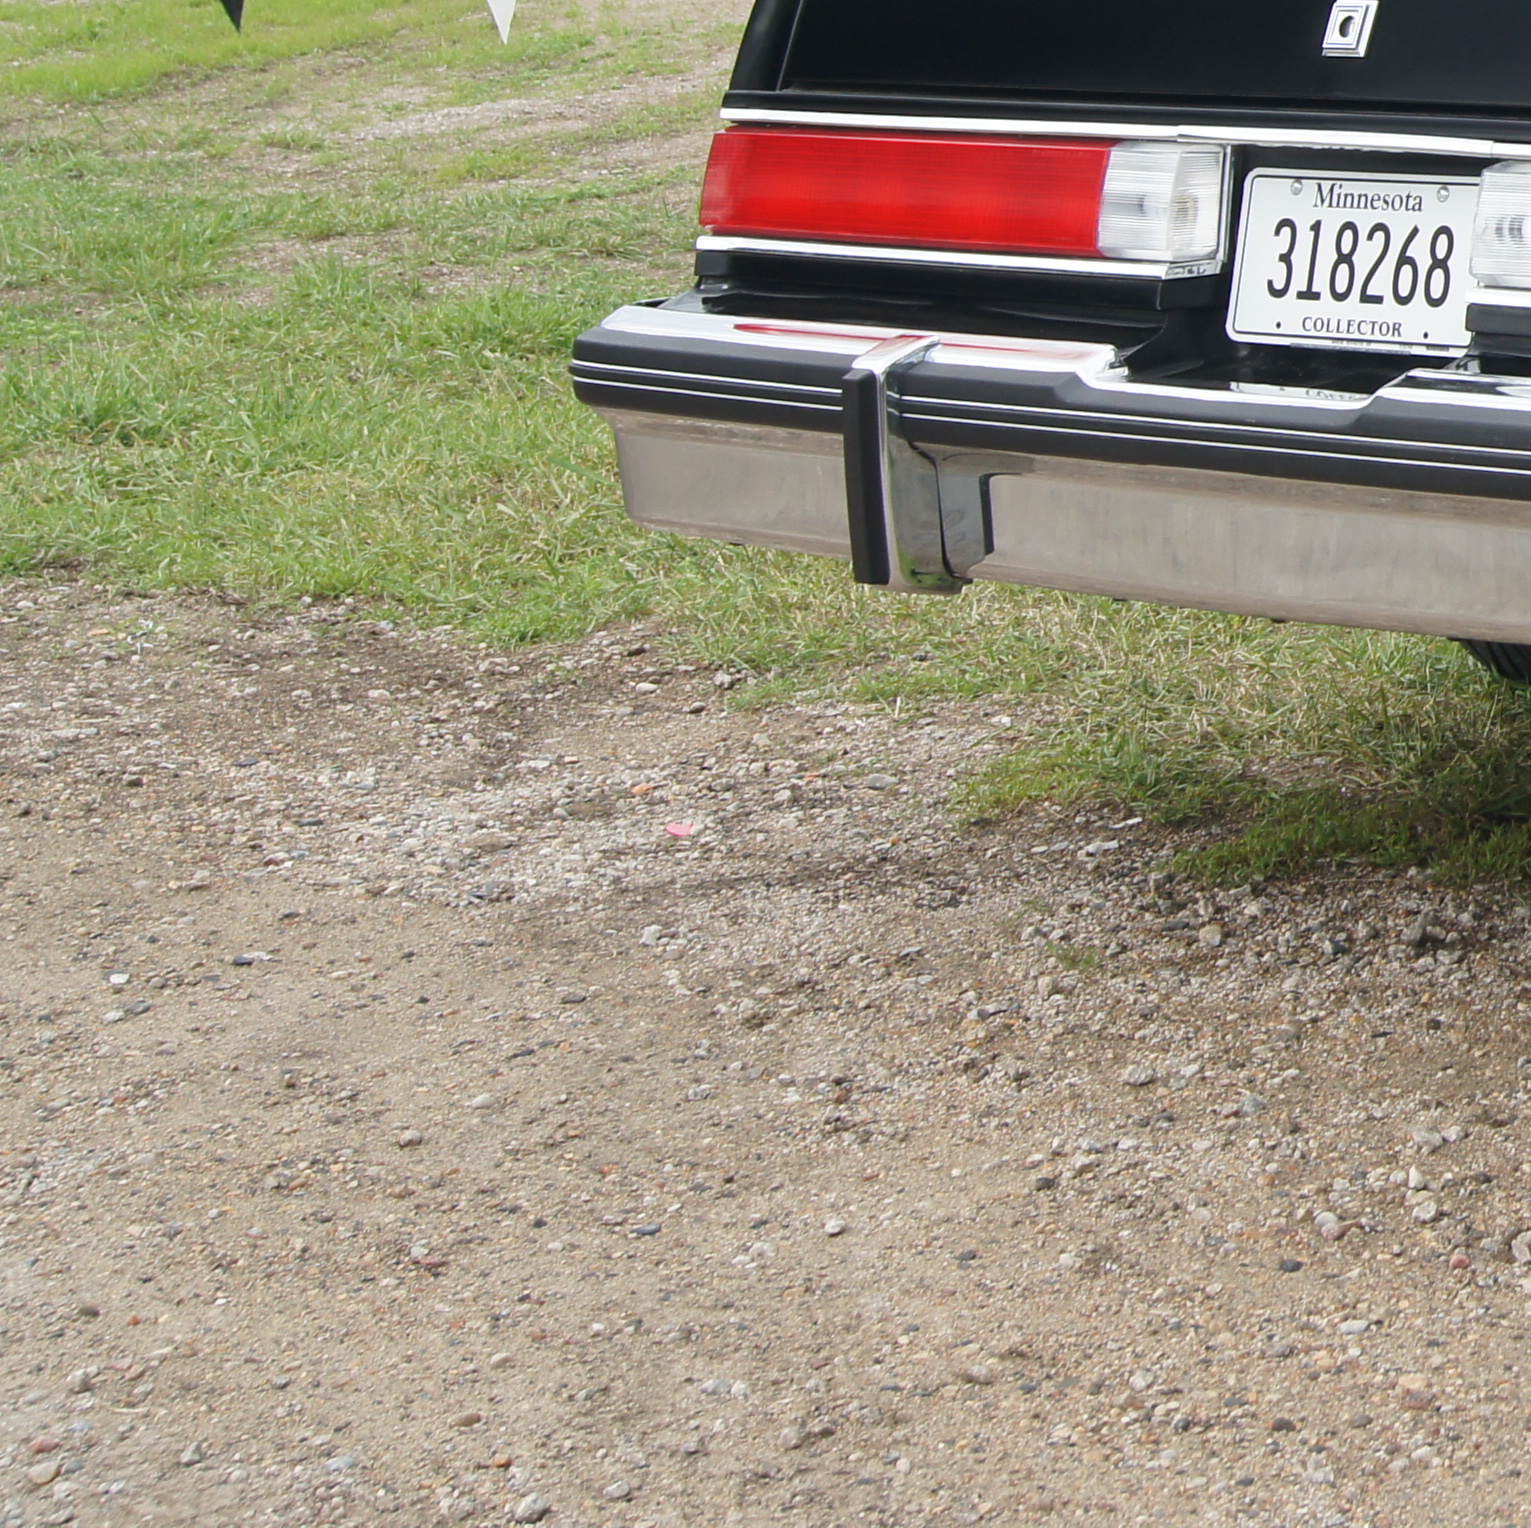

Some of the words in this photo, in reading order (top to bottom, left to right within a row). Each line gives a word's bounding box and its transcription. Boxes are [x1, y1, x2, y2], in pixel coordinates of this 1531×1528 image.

[1312, 181, 1424, 213] Minnesota
[1267, 217, 1455, 309] 318268
[1301, 316, 1403, 339] COLLECTOR
